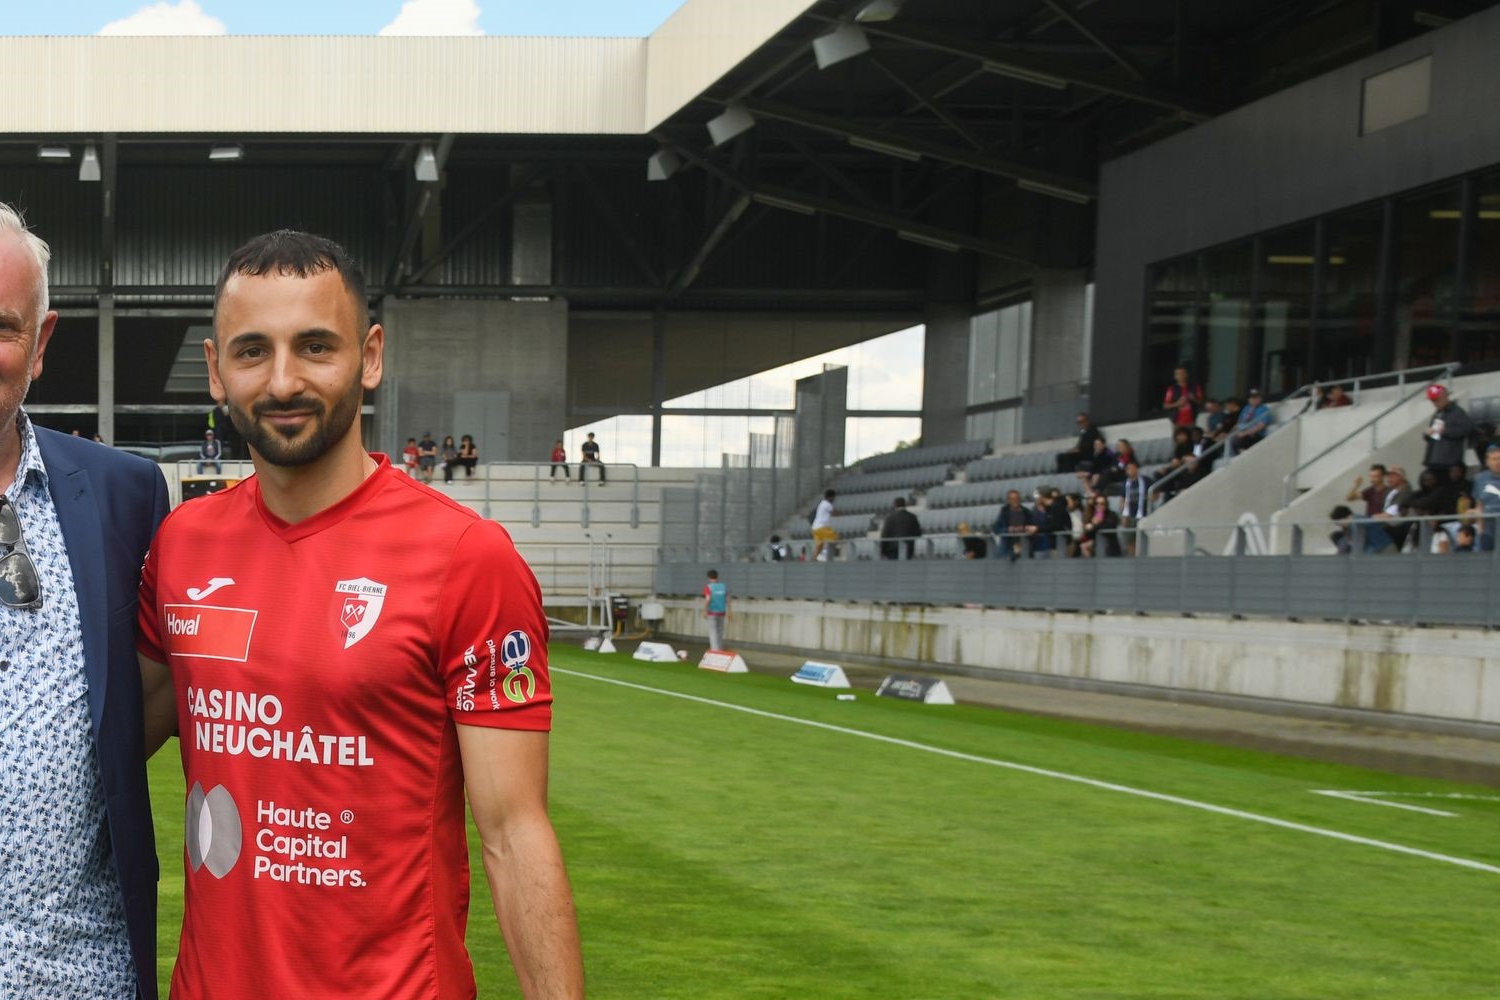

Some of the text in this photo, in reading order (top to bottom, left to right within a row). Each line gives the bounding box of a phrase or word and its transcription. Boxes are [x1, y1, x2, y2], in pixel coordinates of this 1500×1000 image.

[347, 584, 383, 594] BIEL-BIENNE
[167, 613, 201, 636] Hoval
[485, 639, 497, 678] pleasure
[187, 686, 283, 726] CASINO
[489, 688, 501, 711] work
[195, 721, 374, 767] NEUCHÂTEL
[257, 799, 332, 830] Haute
[256, 823, 347, 861] Capital
[253, 855, 367, 888] Partners.
